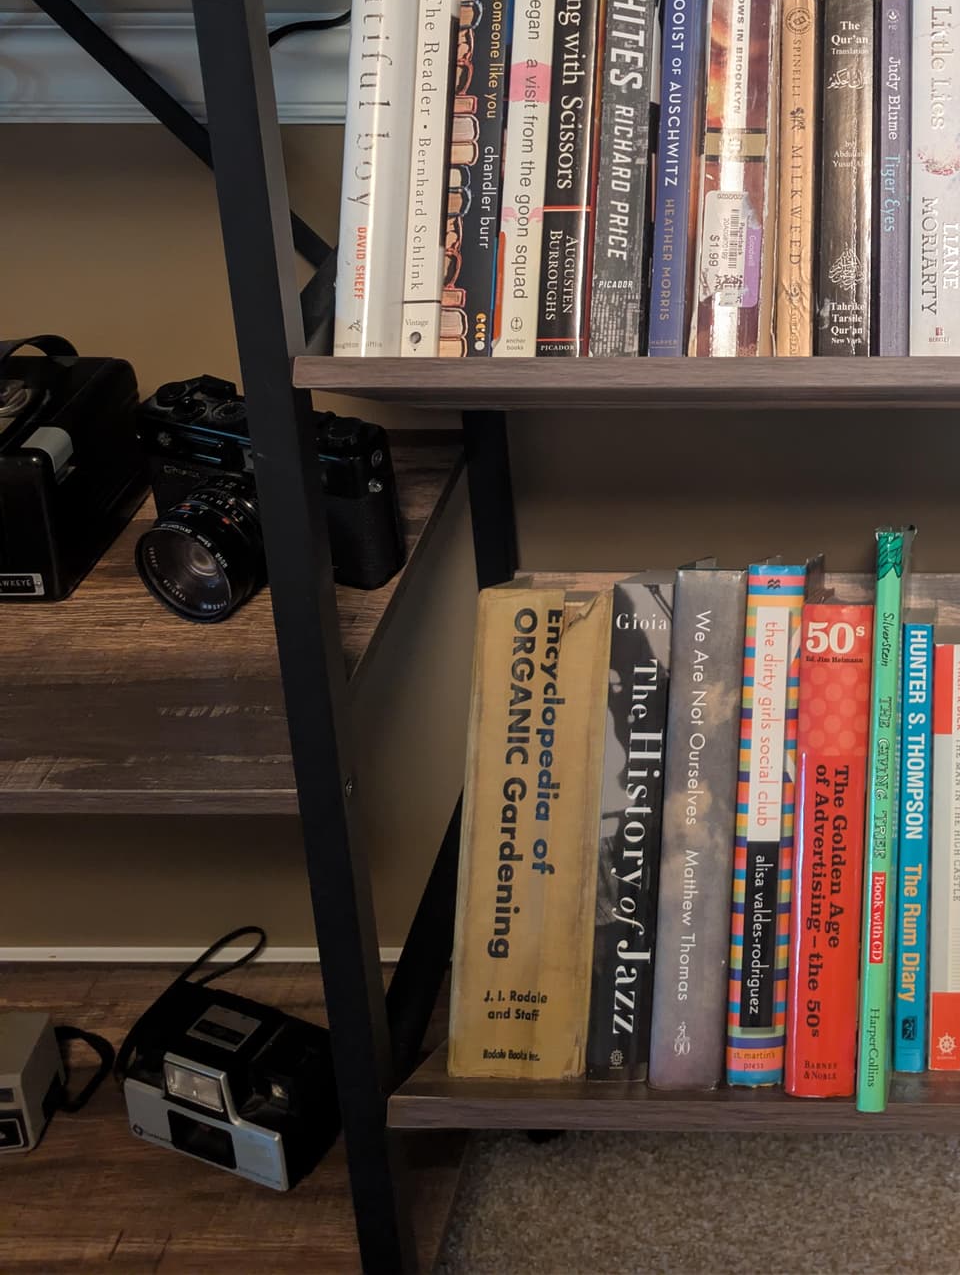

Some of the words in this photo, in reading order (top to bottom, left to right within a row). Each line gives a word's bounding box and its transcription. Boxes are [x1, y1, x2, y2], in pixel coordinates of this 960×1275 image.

[525, 0, 540, 40] egan
[737, 28, 744, 42] IN
[832, 35, 869, 45] Qur'an
[840, 21, 860, 30] The
[419, 40, 440, 116] Reader
[562, 33, 587, 85] with
[889, 57, 900, 92] Judy
[556, 95, 584, 190] Scissors
[888, 96, 900, 140] Blume
[612, 105, 634, 192] RICHARD
[881, 154, 900, 194] Tiger
[416, 138, 431, 215] Bernhard
[480, 146, 499, 211] chandler
[608, 200, 630, 261] PRICE
[662, 199, 674, 262] HEATHER
[790, 146, 803, 264] MILKWEED
[881, 197, 900, 233] Eyes
[357, 227, 367, 260] DAVID
[411, 226, 427, 290] Schlink
[479, 217, 496, 249] burr
[921, 197, 937, 316] MORIARTY
[943, 223, 959, 289] LIANE
[353, 265, 366, 300] SHEFF
[546, 230, 563, 321] BURROUGHS
[562, 235, 578, 313] AUGUSTEN
[599, 280, 633, 289] PICADOR
[660, 268, 673, 321] MORRIS
[405, 318, 428, 326] Vintage
[616, 613, 668, 630] Gioia
[805, 622, 865, 653] 50s
[881, 612, 895, 667] Silverstein
[505, 608, 537, 765] ORGANIC
[630, 659, 658, 718] The
[611, 729, 663, 889] History
[488, 778, 526, 958] Gardening
[683, 849, 699, 926] Matthew
[874, 876, 884, 907] Book
[611, 897, 644, 935] of
[872, 910, 882, 936] with
[678, 933, 696, 1000] Thomas
[872, 940, 881, 959] CD
[612, 940, 651, 1034] Jazz
[868, 1008, 880, 1087] HarperCollins
